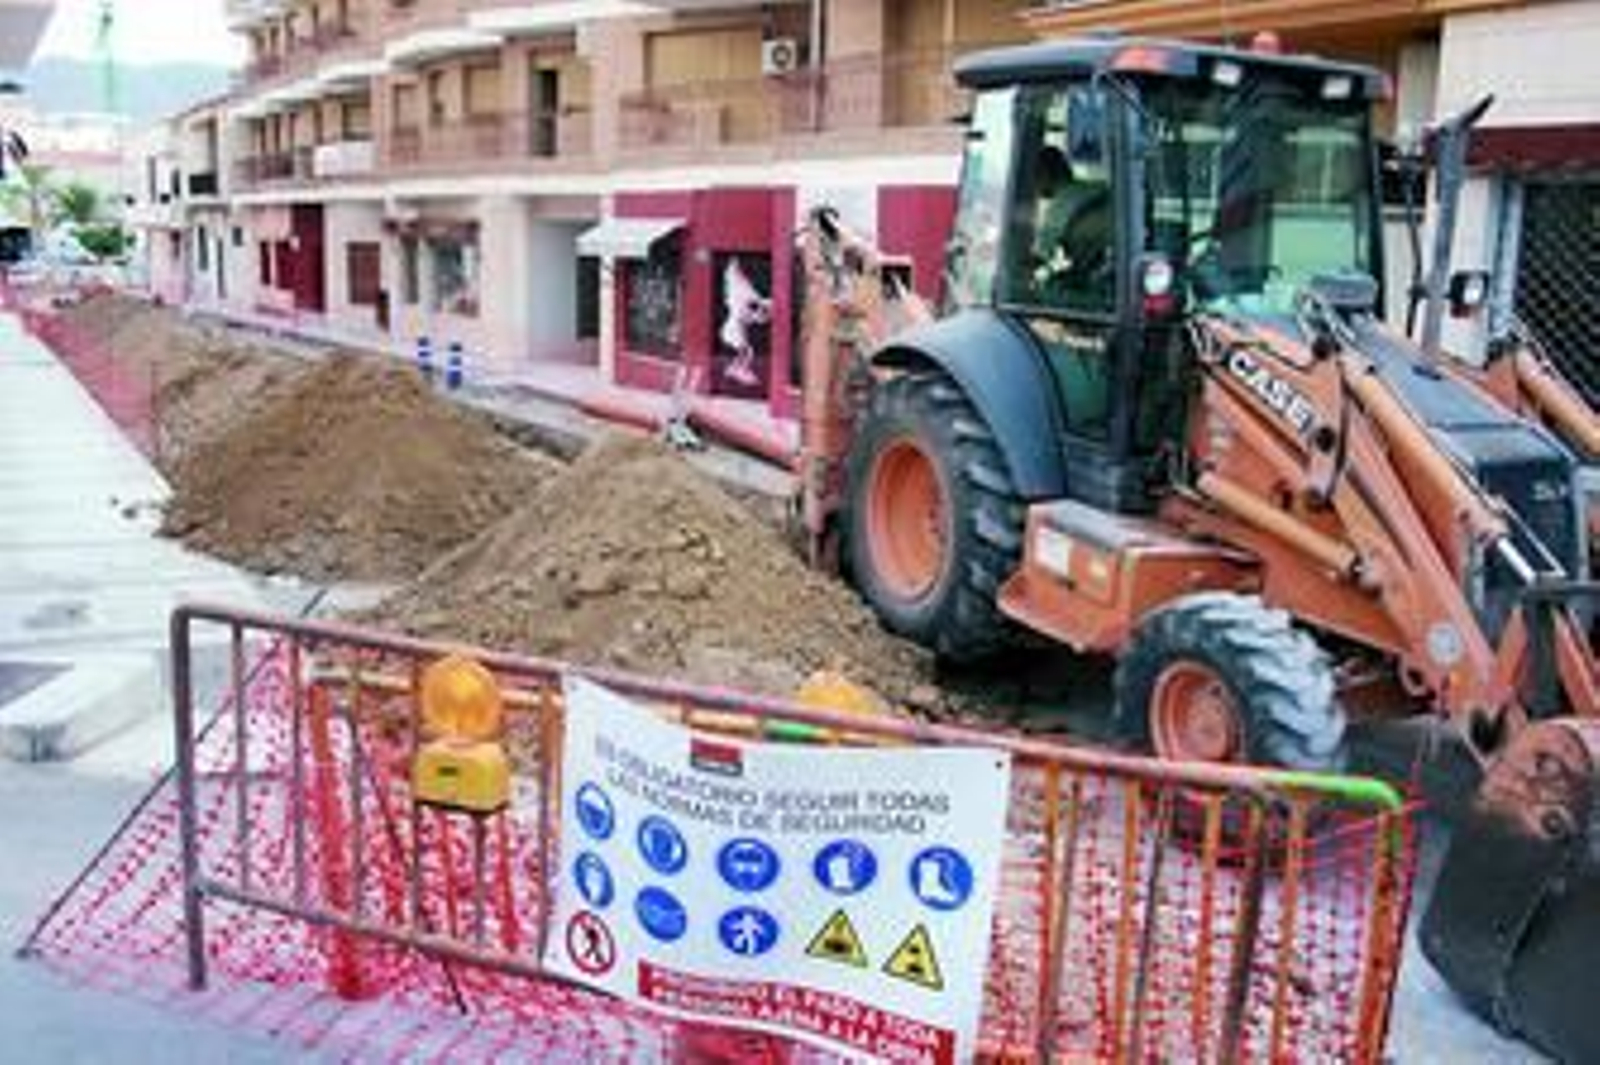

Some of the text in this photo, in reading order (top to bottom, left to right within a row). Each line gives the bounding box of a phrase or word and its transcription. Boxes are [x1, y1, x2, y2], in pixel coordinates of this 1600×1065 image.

[1229, 351, 1314, 433] CASE
[642, 783, 733, 826] NORMAS
[739, 809, 771, 830] DE
[780, 814, 926, 834] SEGURIDAD
[764, 789, 858, 812] SEGUIR
[866, 790, 950, 814] TODAS
[863, 1010, 878, 1030] A
[847, 1023, 869, 1047] LA
